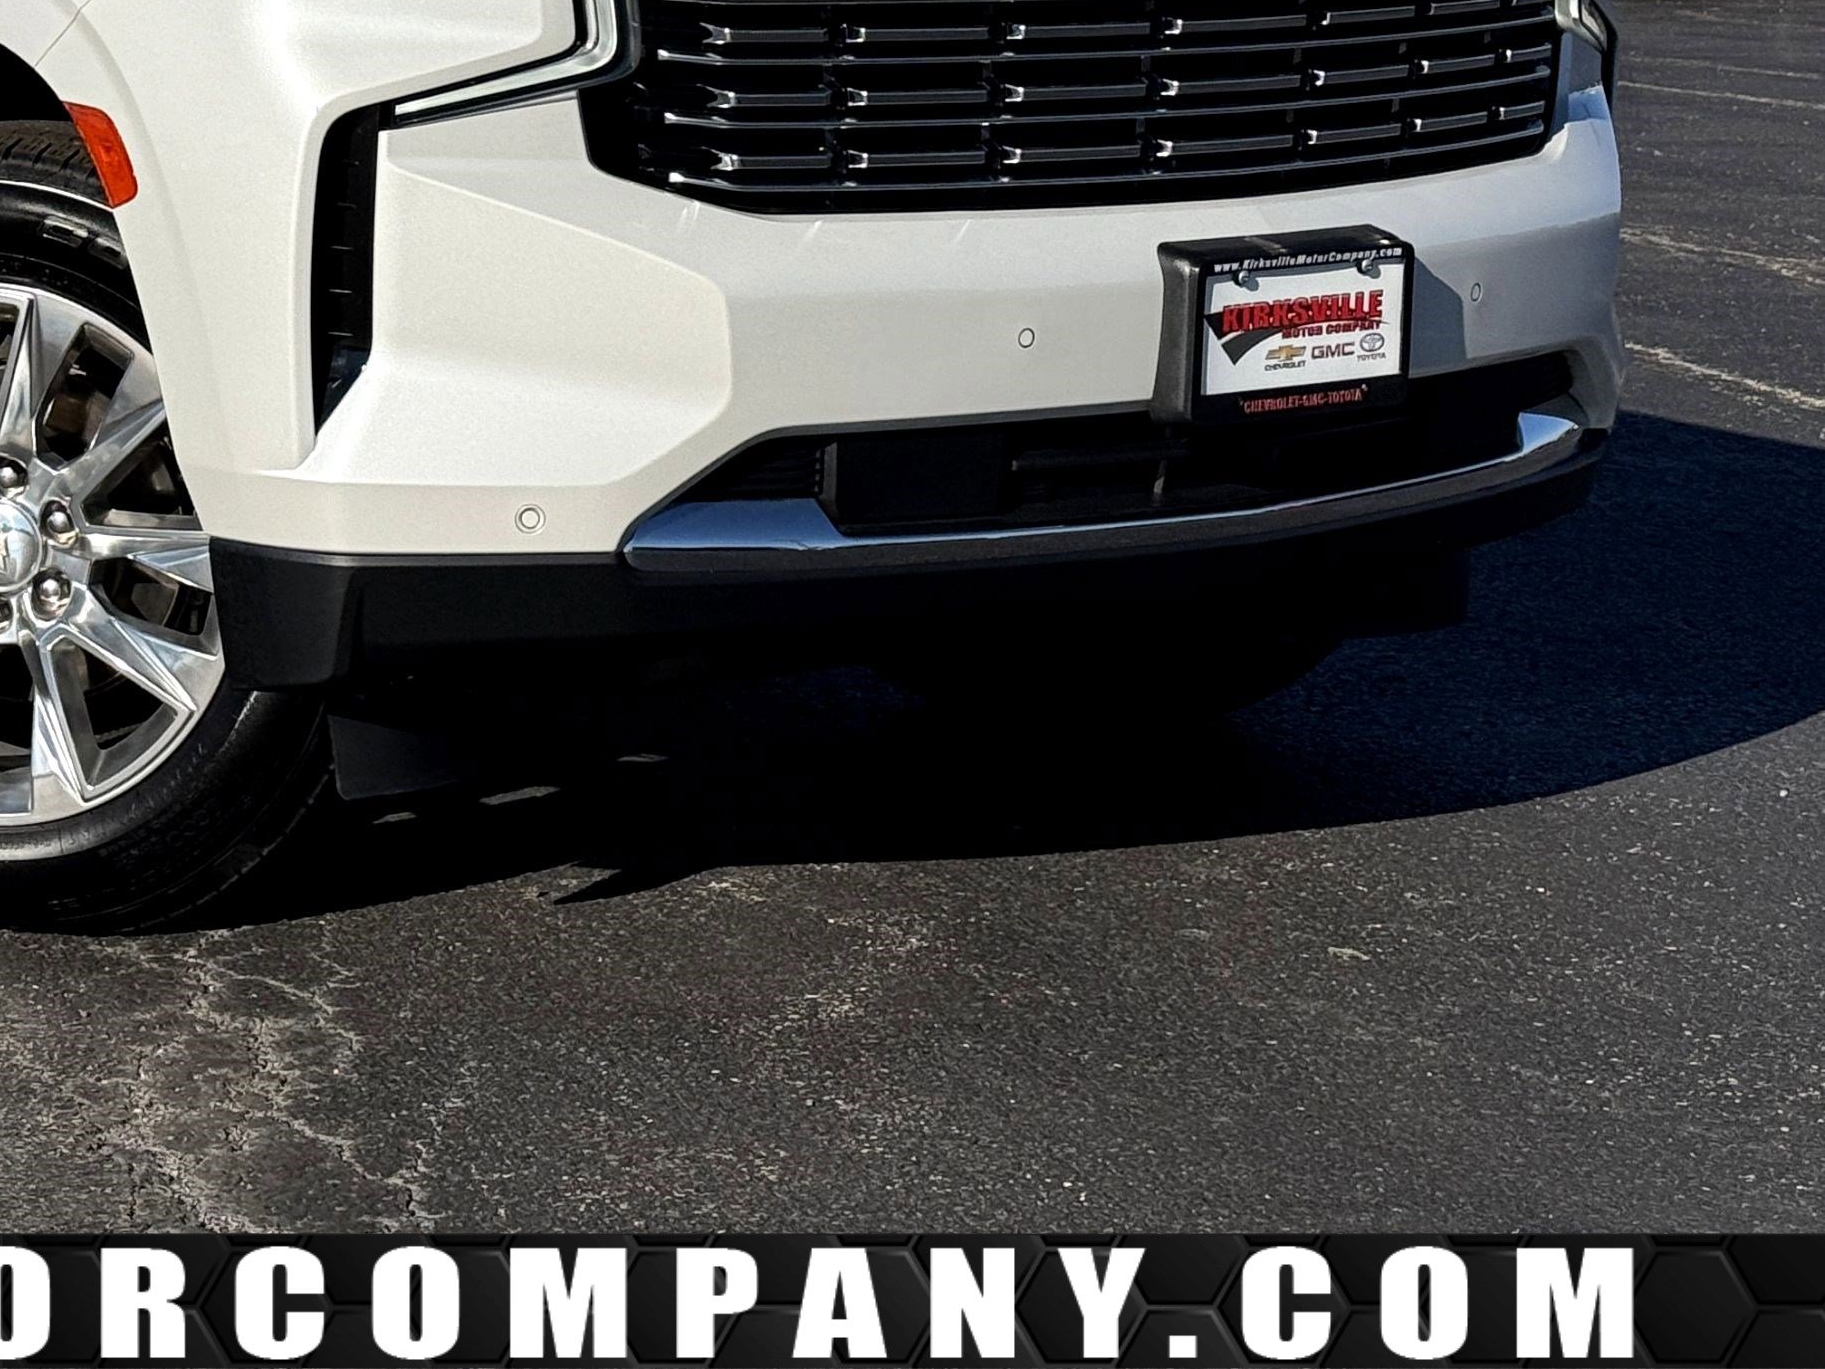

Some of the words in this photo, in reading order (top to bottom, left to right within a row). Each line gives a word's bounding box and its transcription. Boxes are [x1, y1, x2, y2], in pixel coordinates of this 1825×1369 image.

[1214, 247, 1402, 273] www.KirksvilleMotorCompany.com
[1221, 289, 1384, 334] KIRKSVILLE
[1281, 324, 1323, 339] MOTOR
[1326, 319, 1382, 335] COMPANY
[1311, 342, 1355, 359] GMC
[1357, 353, 1386, 362] TOYOTA
[1264, 360, 1306, 372] CHEVROLET
